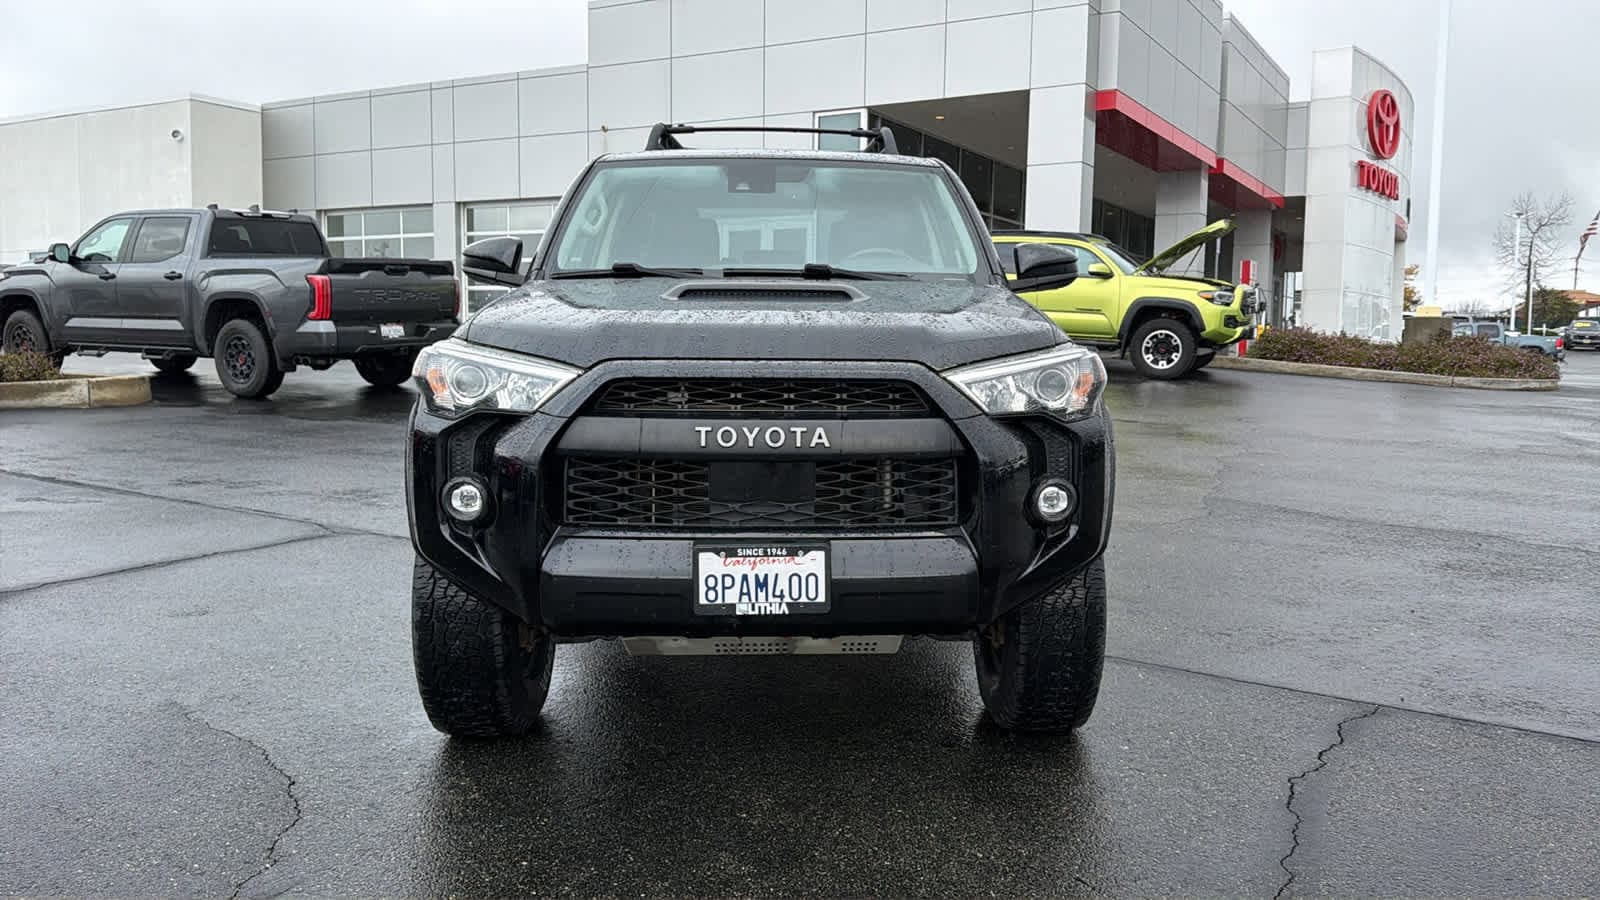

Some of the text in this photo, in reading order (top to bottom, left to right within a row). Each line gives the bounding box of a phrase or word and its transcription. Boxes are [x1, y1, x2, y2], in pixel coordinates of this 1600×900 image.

[1357, 160, 1399, 200] TOYOTA
[695, 426, 831, 448] TOYOTA
[737, 548, 787, 556] SINCE 1946
[721, 556, 805, 571] California
[704, 572, 819, 603] 8PAM400
[748, 602, 789, 615] LITHIA
